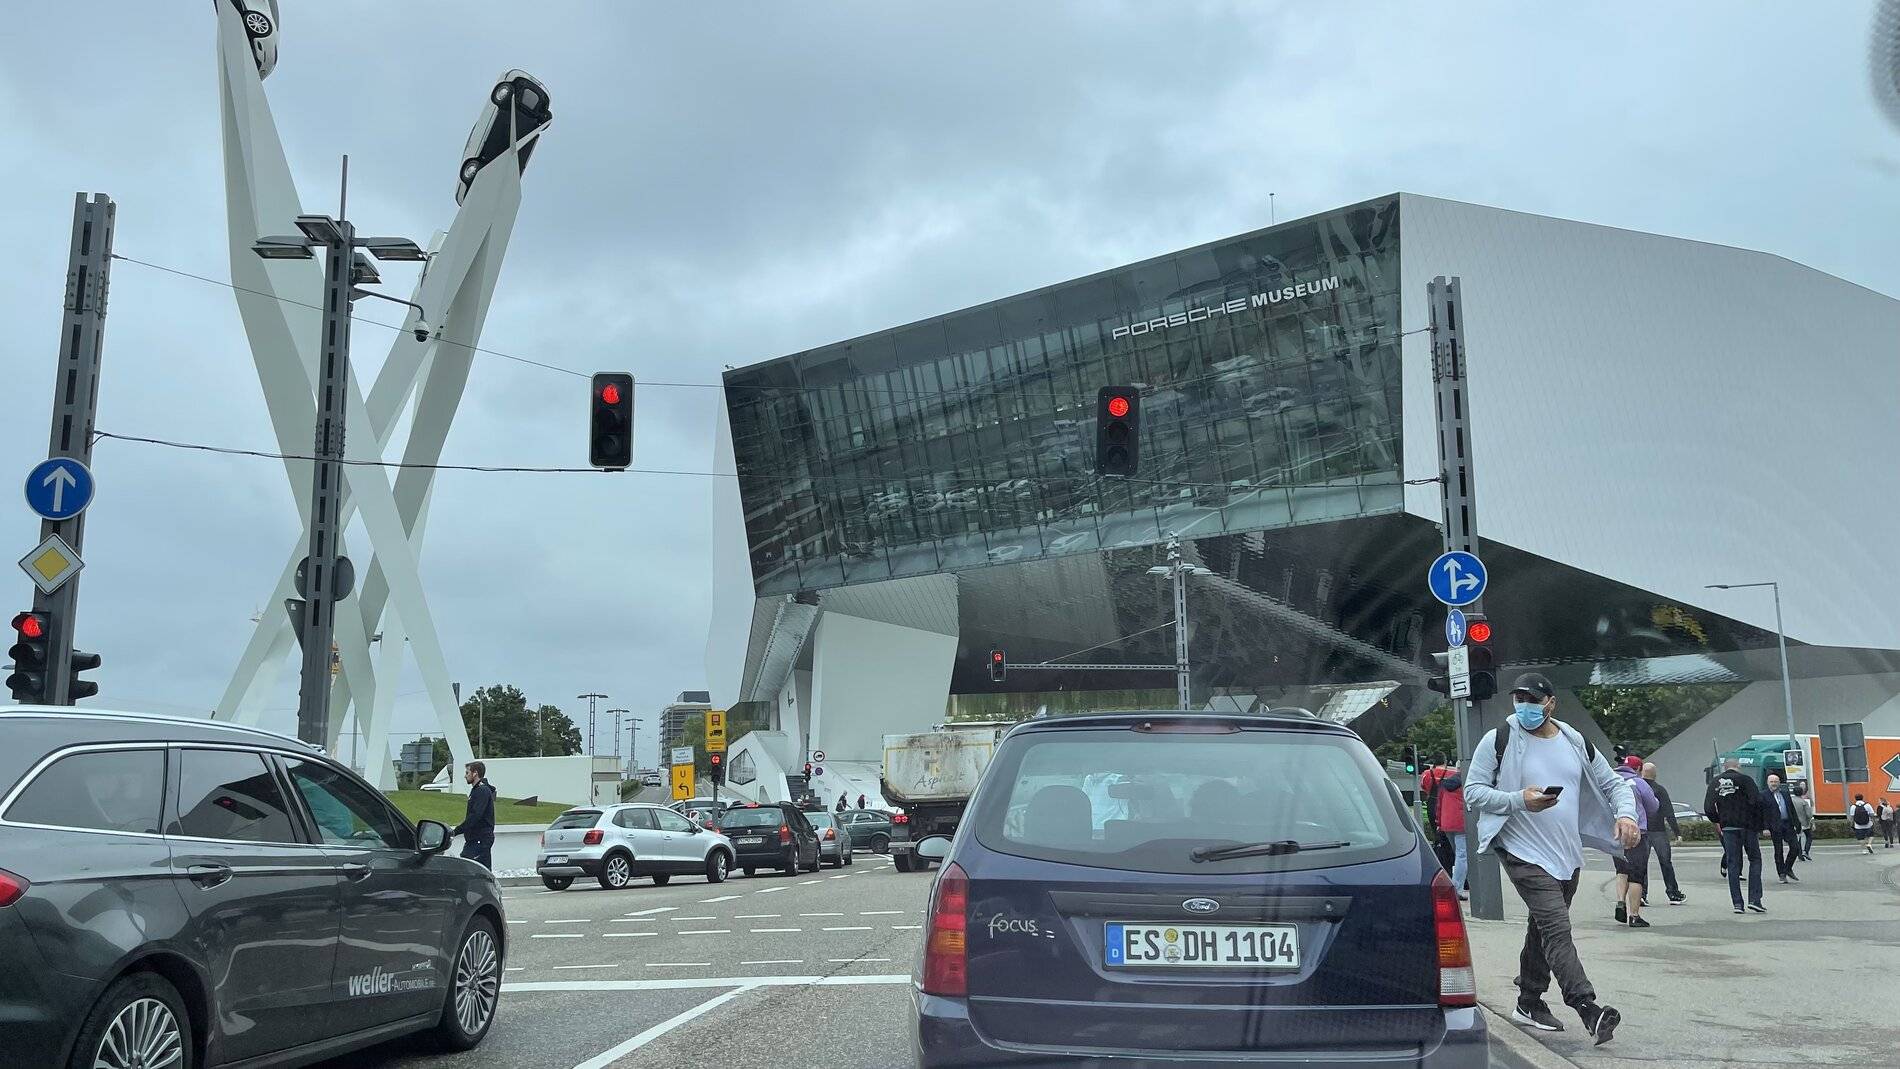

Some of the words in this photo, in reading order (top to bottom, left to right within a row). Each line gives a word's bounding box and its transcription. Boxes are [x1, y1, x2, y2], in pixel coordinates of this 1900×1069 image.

[1112, 297, 1247, 340] PORSCHE
[1251, 276, 1340, 308] MUSEUM
[680, 770, 686, 778] U
[1126, 930, 1160, 960] ES
[1183, 931, 1218, 961] DH
[1225, 931, 1294, 962] 1104
[349, 966, 394, 996] weller
